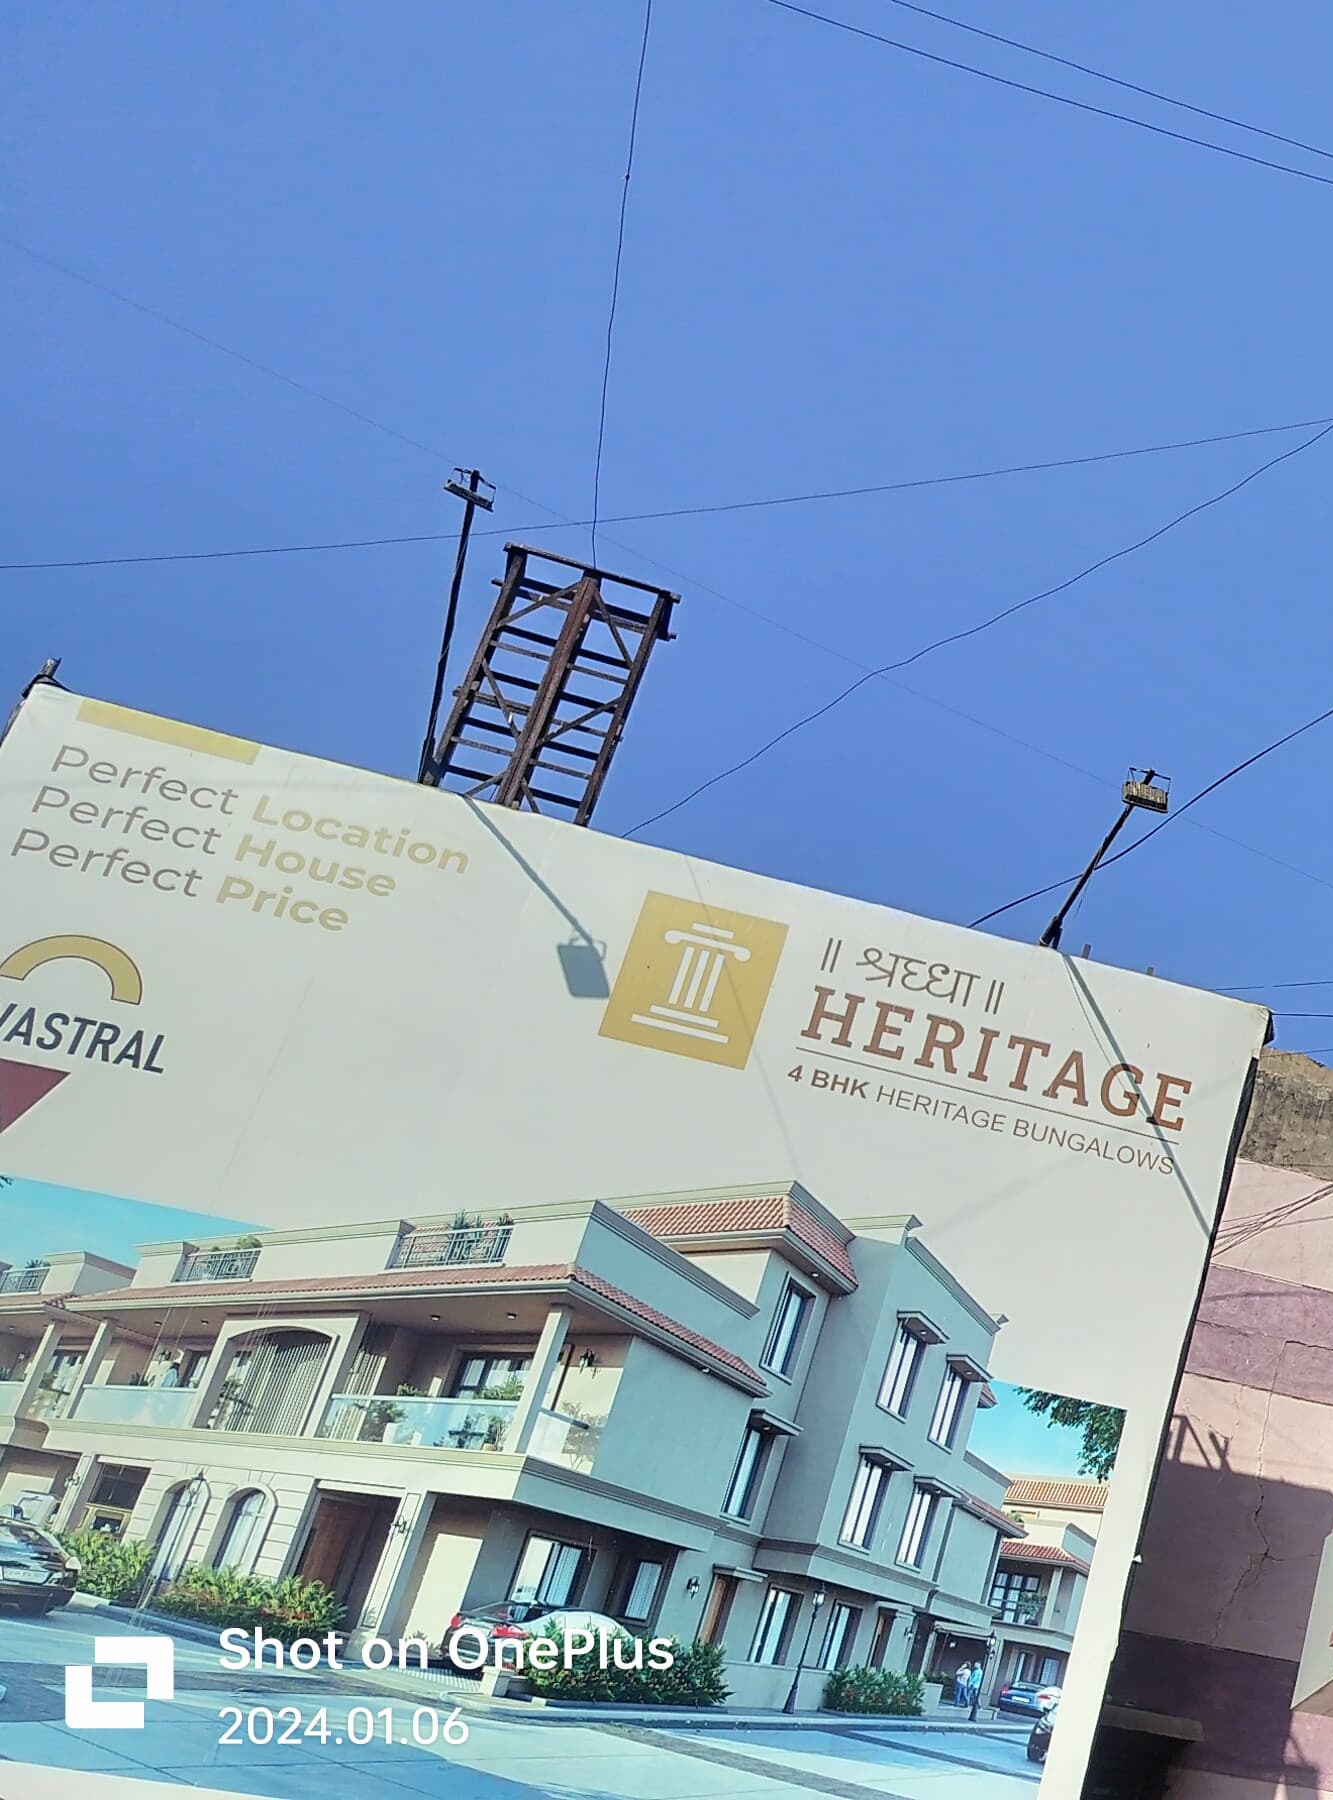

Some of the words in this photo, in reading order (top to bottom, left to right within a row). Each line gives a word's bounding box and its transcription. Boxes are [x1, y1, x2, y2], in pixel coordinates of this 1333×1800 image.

[31, 785, 220, 854] Perfect
[234, 834, 396, 897] House
[51, 744, 239, 815] Perfect
[251, 794, 469, 875] Location
[10, 827, 202, 897] Perfect
[215, 875, 349, 932] Price
[800, 985, 1192, 1131] HERITAGE
[787, 1065, 802, 1083] 4
[810, 1069, 870, 1099] BHK
[876, 1086, 1006, 1133] HERITAGE
[1013, 1119, 1175, 1175] BUNGALOWS
